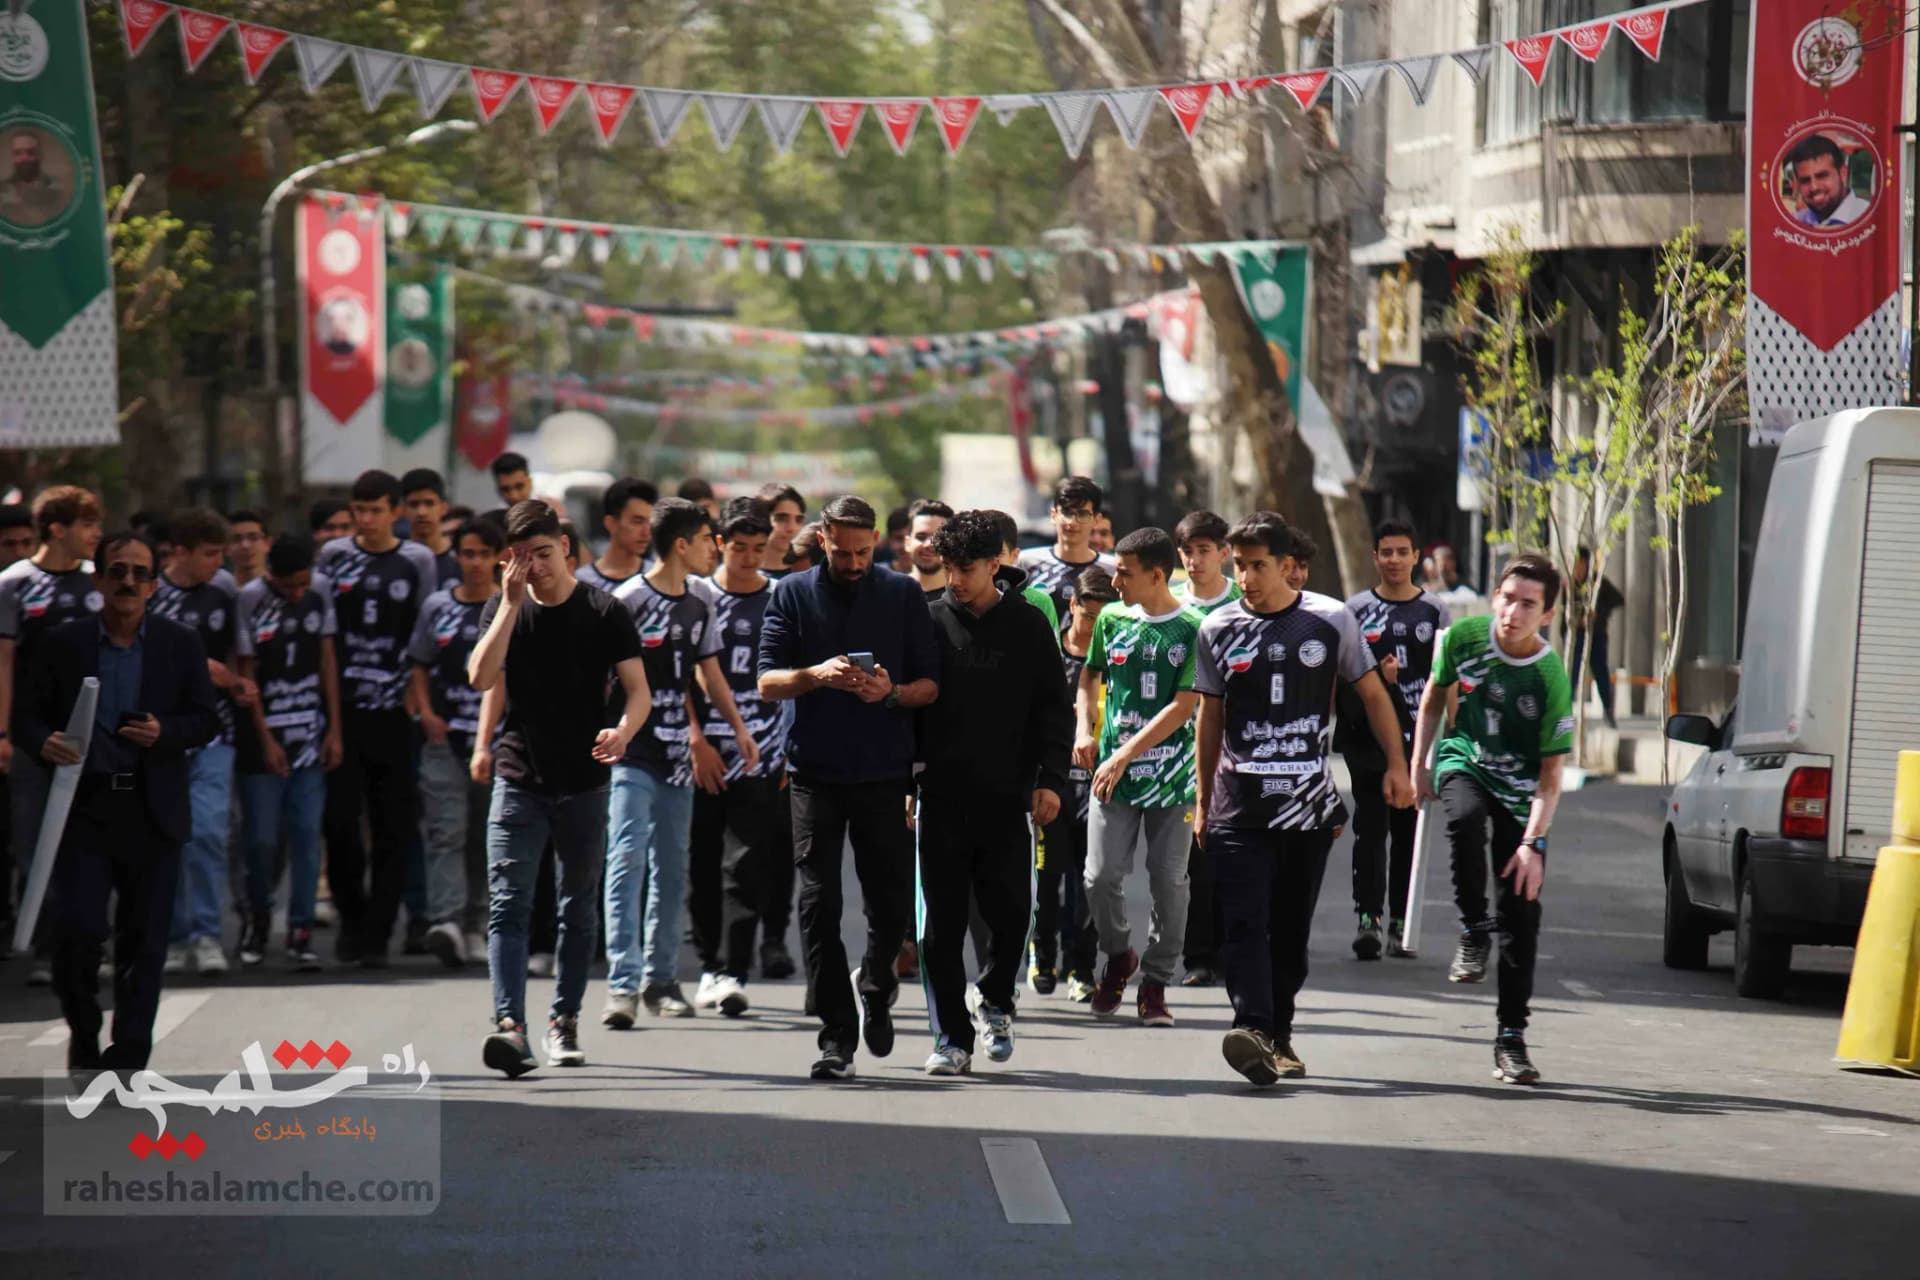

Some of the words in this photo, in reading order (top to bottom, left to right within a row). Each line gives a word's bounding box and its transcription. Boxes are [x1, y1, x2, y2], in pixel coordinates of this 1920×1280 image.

[363, 599, 378, 624] 5
[730, 645, 752, 673] 12
[1140, 671, 1157, 699] 16
